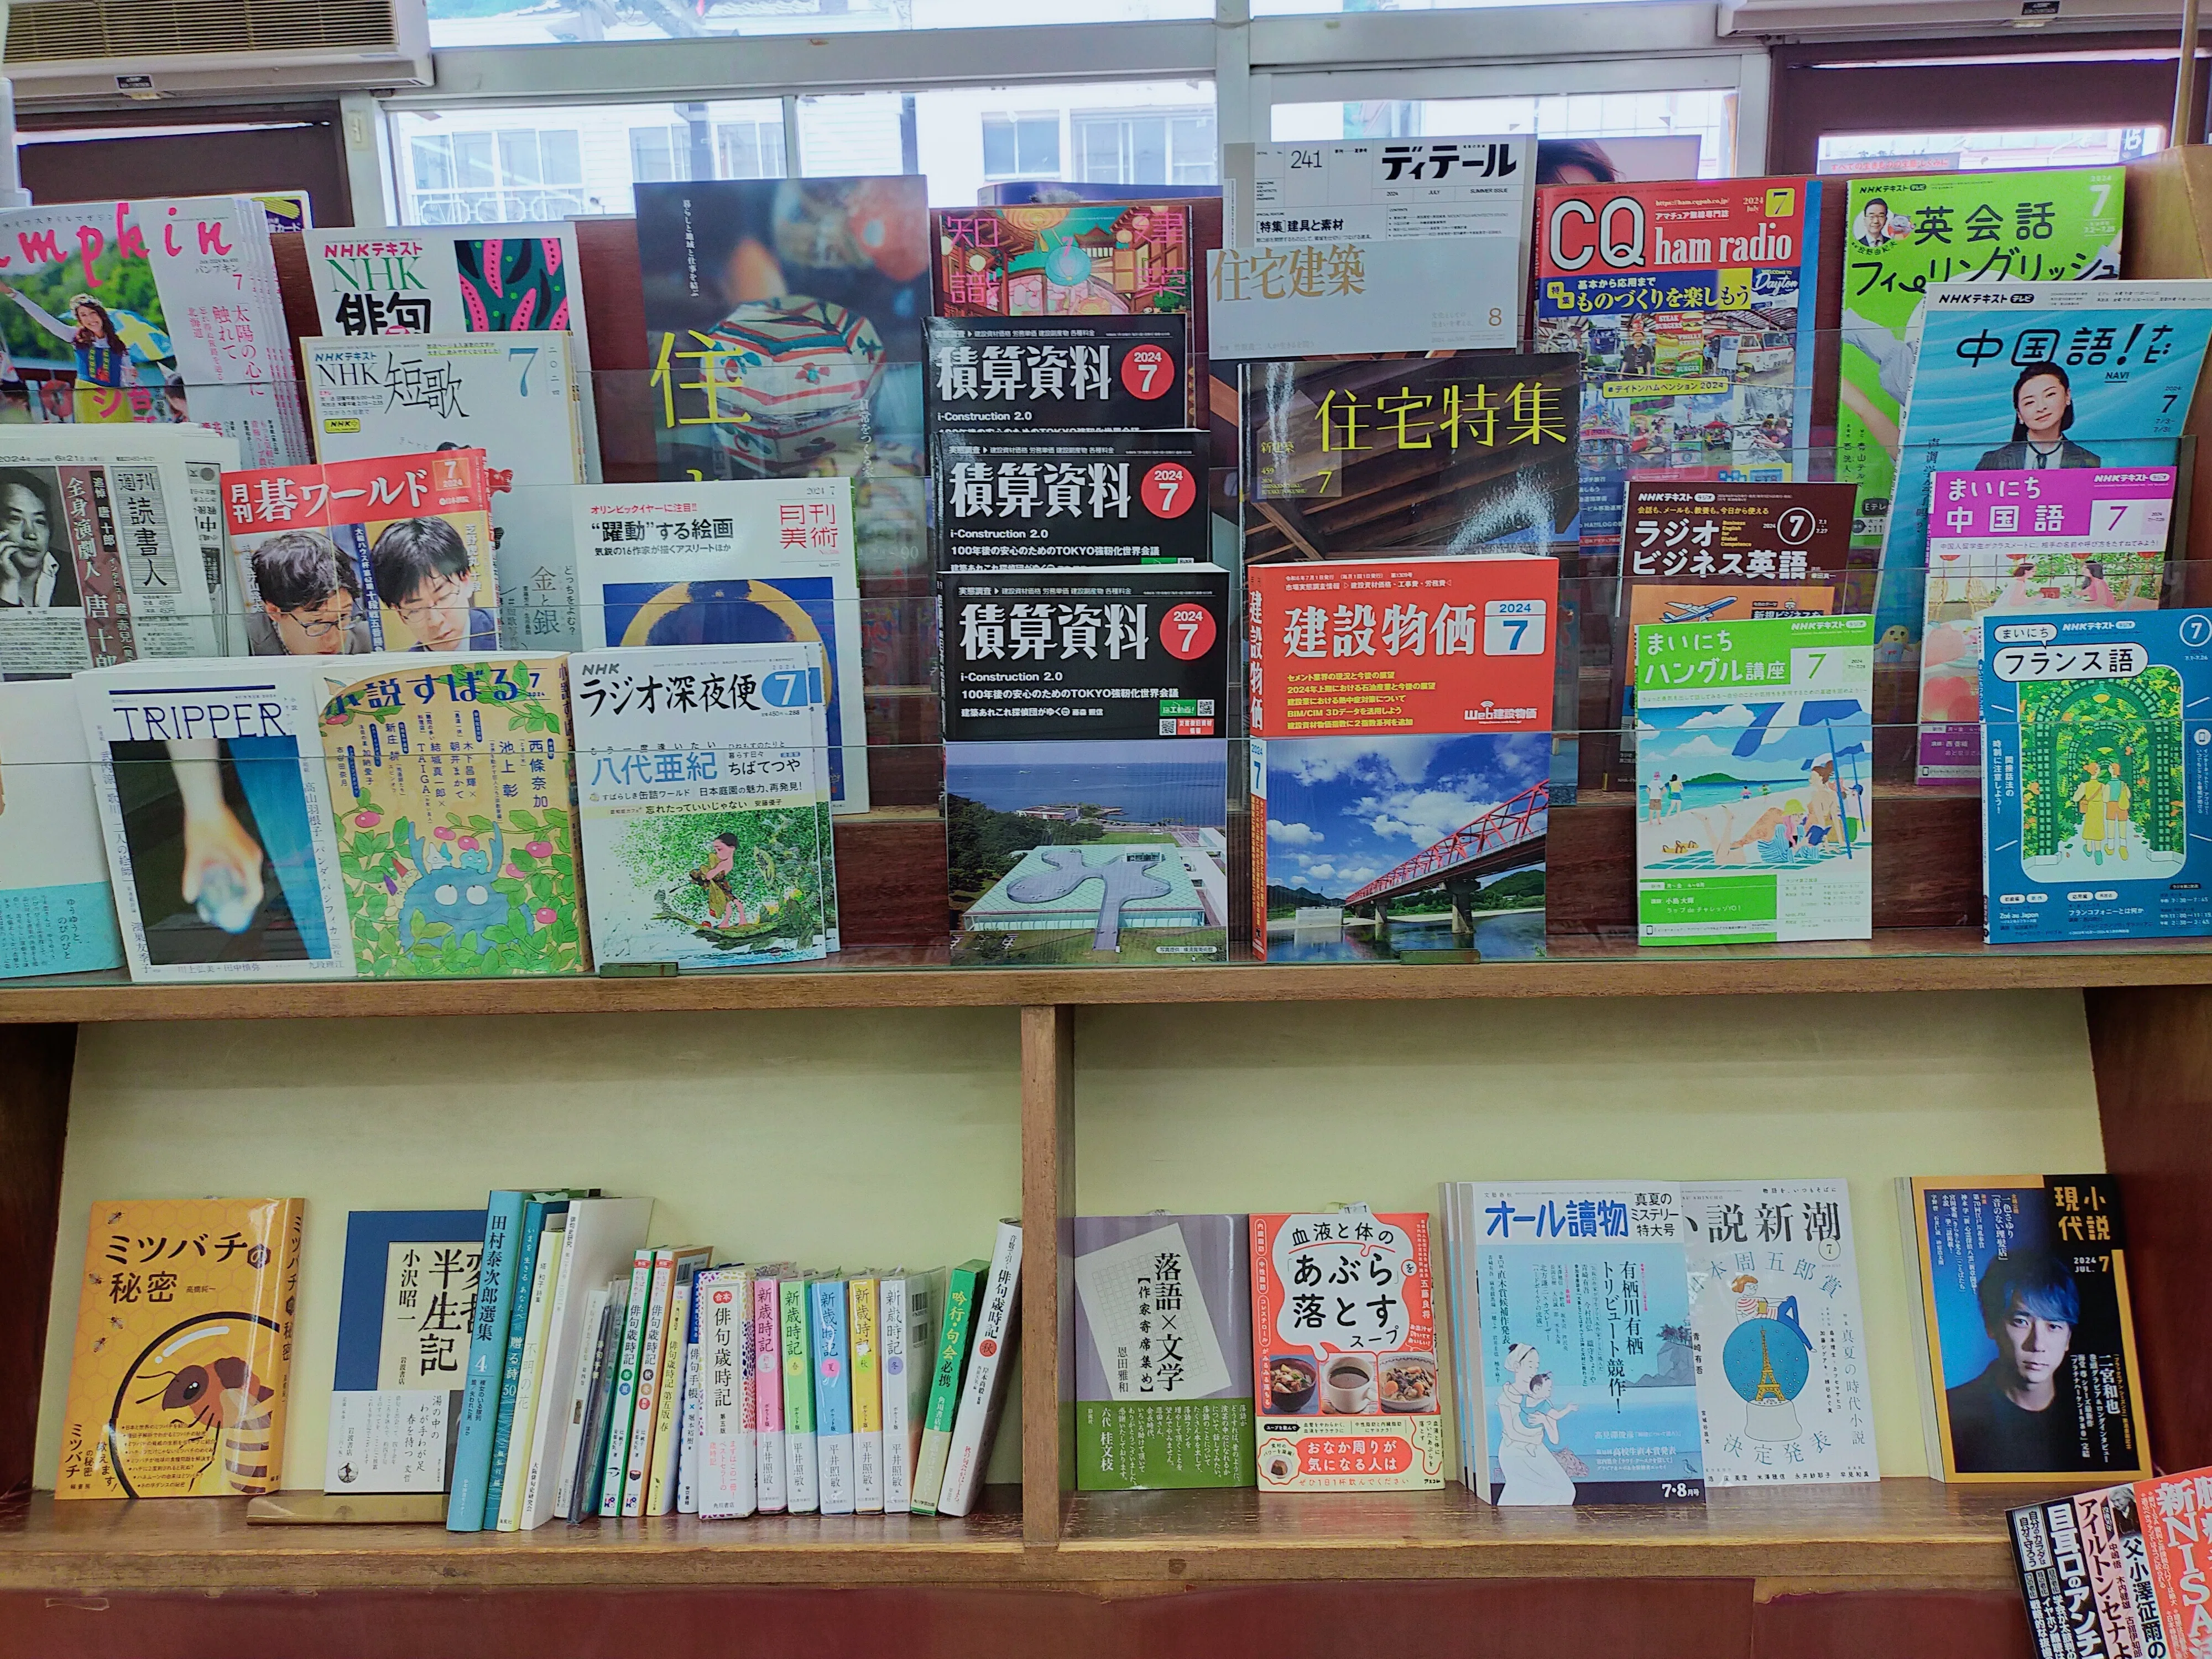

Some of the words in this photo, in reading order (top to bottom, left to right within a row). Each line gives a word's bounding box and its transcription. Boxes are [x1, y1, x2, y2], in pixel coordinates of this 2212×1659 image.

[1291, 150, 1322, 169] 241
[1382, 144, 1517, 180] ディテール
[1772, 192, 1788, 215] 7
[1860, 184, 1908, 194] NHKテキスト
[2090, 184, 2110, 217] 7
[1550, 196, 1645, 271] CQ
[1654, 227, 1712, 265] ham
[1718, 222, 1792, 262] radio
[1915, 202, 2055, 246] 英会話
[325, 243, 423, 258] NHKテキスト
[1062, 237, 1073, 257] 7
[232, 274, 242, 290] 7
[329, 257, 429, 292] NHK
[1209, 244, 1367, 302] 住宅建築
[1578, 277, 1656, 290] 基本から応用まで
[1578, 284, 1749, 312] ものづくりを楽しもう
[1939, 294, 2007, 304] NHKテキスト
[1489, 308, 1502, 326] 8
[213, 306, 237, 359] 触れて
[315, 352, 377, 362] NHKテキスト
[1134, 352, 1162, 363] 2024
[316, 363, 382, 387] NHK
[384, 351, 470, 419] 短歌
[508, 348, 539, 397] 7
[937, 345, 1112, 401] 積算資料
[1138, 364, 1158, 393] 7
[1700, 381, 1723, 390] 2024
[937, 412, 1011, 422] i-Construction
[1014, 411, 1032, 421] 2.0
[1314, 382, 1567, 452] 住宅特集
[2161, 394, 2178, 413] 7
[1261, 441, 1295, 454] 新建築
[117, 473, 156, 491] 週刊
[442, 478, 463, 487] 2024
[444, 461, 457, 479] 7
[1154, 470, 1183, 481] 2024
[1317, 471, 1333, 494] 7
[2094, 474, 2148, 483] NHKテキスト
[254, 468, 429, 523] 碁ワールド
[807, 487, 825, 495] 2024
[949, 462, 1132, 519] 積算資料
[1159, 483, 1178, 512] 7
[1638, 493, 1693, 502] NHKテキスト
[1949, 476, 2041, 501] まいにち
[231, 484, 252, 524] 月刊
[780, 504, 835, 525] 月刊
[1947, 504, 2065, 534] 中国語
[2110, 506, 2128, 531] 7
[779, 526, 838, 550] 美術
[950, 529, 1026, 539] i-Construction
[1030, 529, 1049, 539] 2.0
[1635, 518, 1720, 547] ラジオ
[1790, 515, 1804, 538] 7
[1632, 549, 1808, 580] ビジネス英語
[531, 566, 561, 635] 金と銀
[1499, 603, 1532, 613] 2024
[959, 603, 1149, 660] 積算資料
[1173, 611, 1203, 622] 2024
[1284, 603, 1477, 658] 建設物価
[1792, 620, 1845, 630] NHKテキスト
[2063, 622, 2115, 632] NHKテキスト
[2190, 622, 2203, 639] 7
[1177, 623, 1199, 653] 7
[1503, 619, 1528, 651] 7
[1647, 629, 1733, 655] まいにち
[2002, 626, 2049, 640] まいにち
[582, 663, 620, 676] NHK
[1249, 590, 1264, 731] 建設物価
[1644, 659, 1786, 685] ハングル講座
[1808, 653, 1827, 679] 7
[2005, 648, 2133, 674] フランス語
[529, 672, 540, 688] 7
[774, 674, 796, 706] 7
[961, 672, 1040, 682] i-Construction
[1043, 672, 1063, 682] 2.0
[325, 669, 519, 717] 小説すばる
[580, 672, 762, 718] ラジオ深夜便
[113, 703, 286, 741] TRIPPER
[1287, 708, 1323, 718] BIM/CIM
[1326, 706, 1402, 717] 3Dデータを活用しよう
[1464, 708, 1537, 721] Web建設物価
[417, 742, 431, 794] TAIGA
[450, 742, 465, 799] 朝井まかて
[528, 739, 548, 808] 西條奈加
[591, 751, 718, 786] 八代亜紀
[728, 758, 801, 776] ちばてつや
[1253, 761, 1261, 789] 7
[645, 800, 748, 815] 忘れたっていいじゃない
[1634, 1192, 1672, 1206] 真夏の
[2053, 1186, 2083, 1241] 現代
[2083, 1187, 2111, 1241] 小説
[1484, 1198, 1629, 1238] オール讀物
[1630, 1208, 1679, 1222] ミステリー
[1636, 1223, 1676, 1237] 特大号
[1292, 1222, 1394, 1247] 血液と体の
[1825, 1244, 1833, 1255] 7
[106, 1232, 271, 1269] ミツバチの
[1004, 1234, 1017, 1270] 音数で引く
[2074, 1256, 2096, 1265] 2024
[2099, 1256, 2109, 1272] 7
[476, 1214, 507, 1342] 田村泰次郎選集
[1405, 1261, 1413, 1274] を
[109, 1271, 178, 1304] 秘密
[397, 1248, 421, 1322] 小沢昭一
[418, 1248, 465, 1376] 半生記
[984, 1269, 1011, 1339] 俳句歳時記
[1292, 1293, 1397, 1328] 落とす
[1619, 1260, 1644, 1356] 有栖川有栖
[623, 1304, 642, 1365] 俳句歳時記
[644, 1304, 663, 1365] 俳句歳時記
[758, 1286, 775, 1353] 新歳時記
[786, 1290, 803, 1356] 新歳時記
[821, 1291, 839, 1358] 新歳時記
[885, 1290, 902, 1356] 新歳時記
[1154, 1252, 1185, 1392] 落語×文学
[1260, 1298, 1268, 1343] コレステロール
[1350, 1324, 1400, 1348] スープ
[399, 1356, 408, 1386] 岩波書店
[663, 1340, 679, 1389] 俳句歳時記
[713, 1307, 732, 1407] 俳句歳時記
[1117, 1346, 1129, 1393] 恩田雅和
[688, 1348, 700, 1400] 俳句手帳
[1841, 1329, 1866, 1446] 真夏の時代小説
[2099, 1354, 2121, 1415] 二宮和也
[431, 1395, 442, 1439] 湯の中の
[65, 1423, 83, 1478] ミツバチ
[416, 1404, 430, 1472] わが手わが足
[1100, 1431, 1114, 1472] 桂文枝
[1307, 1440, 1397, 1455] おなか周りが
[1723, 1432, 1832, 1465] 決定発表
[763, 1442, 774, 1485] 平井照敏
[793, 1442, 805, 1486] 平井照敏
[1307, 1457, 1397, 1472] 気になる人は
[1299, 1477, 1410, 1487] ぜひ1日1杯飲んでください
[2028, 1511, 2047, 1566] 自分のカラダは
